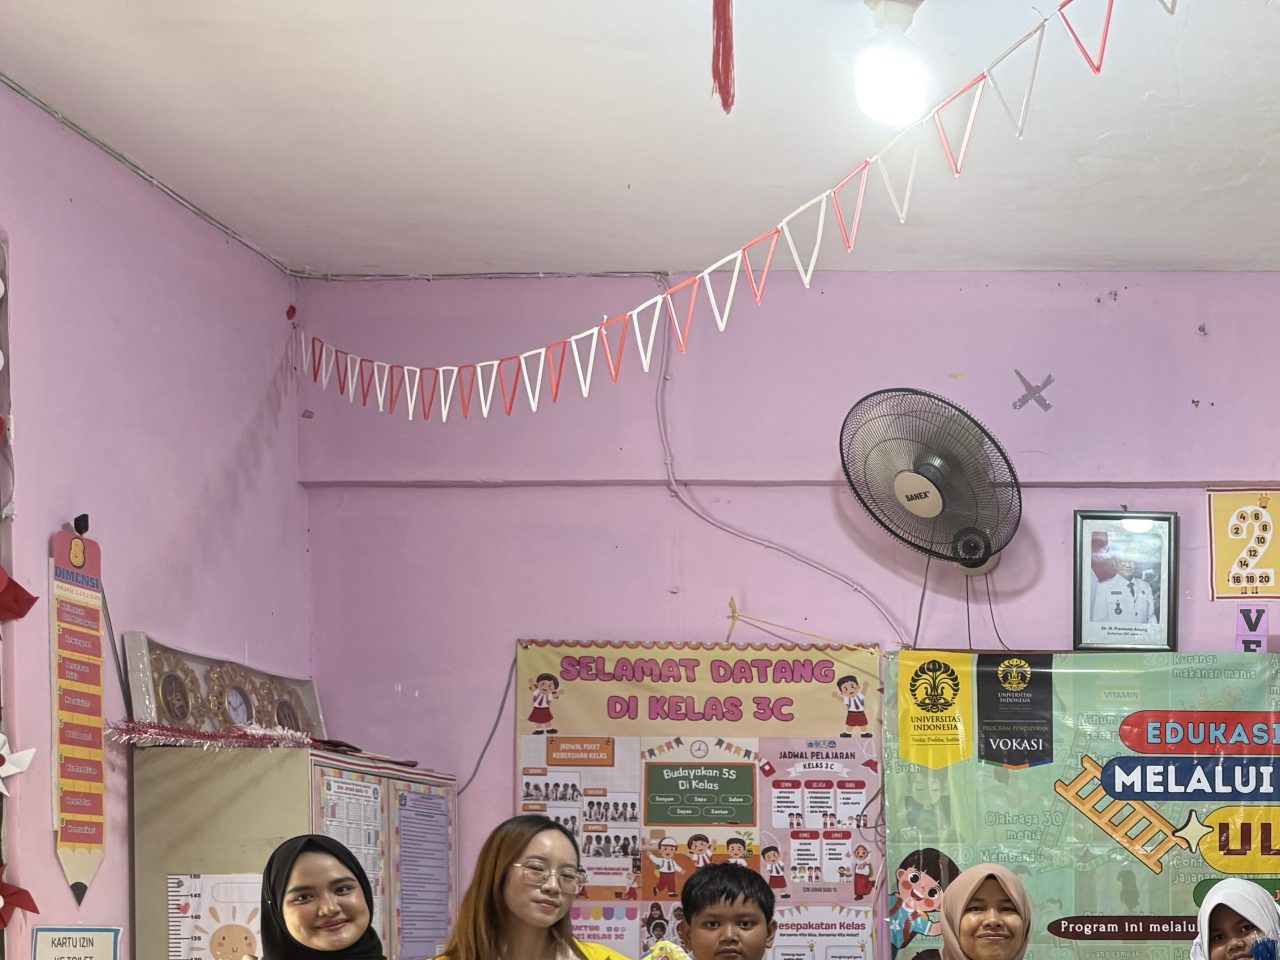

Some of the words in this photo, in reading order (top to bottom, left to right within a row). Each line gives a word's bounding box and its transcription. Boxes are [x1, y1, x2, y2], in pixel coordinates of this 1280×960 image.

[905, 491, 927, 502] SANEX
[55, 565, 98, 588] DIMENSI
[1240, 608, 1265, 632] V
[1173, 654, 1217, 665] Kurangi
[560, 656, 700, 682] SELAMAT
[710, 660, 835, 684] DATANG
[1173, 669, 1222, 680] makanan
[1224, 668, 1256, 679] manis
[1104, 691, 1138, 700] VITAMIN
[607, 696, 638, 720] DI
[648, 696, 742, 721] KELAS
[753, 697, 794, 722] 3C
[990, 739, 1043, 750] VOKASI
[779, 752, 810, 760] JADWAL
[811, 752, 856, 760] PELAJARAN
[663, 766, 719, 778] Budayakan
[722, 768, 736, 779] 5S
[678, 780, 689, 790] Di
[692, 780, 719, 790] Kelas
[1114, 765, 1274, 794] MELALUI
[985, 812, 1039, 826] Olahraga
[1042, 812, 1062, 825] 30
[1006, 829, 1042, 840] menit
[980, 850, 1044, 862] Membantu
[777, 922, 837, 931] esepakatan
[839, 922, 866, 930] Kelas
[1061, 921, 1118, 935] Program
[52, 937, 77, 948] KARTU
[80, 937, 94, 947] IZIN
